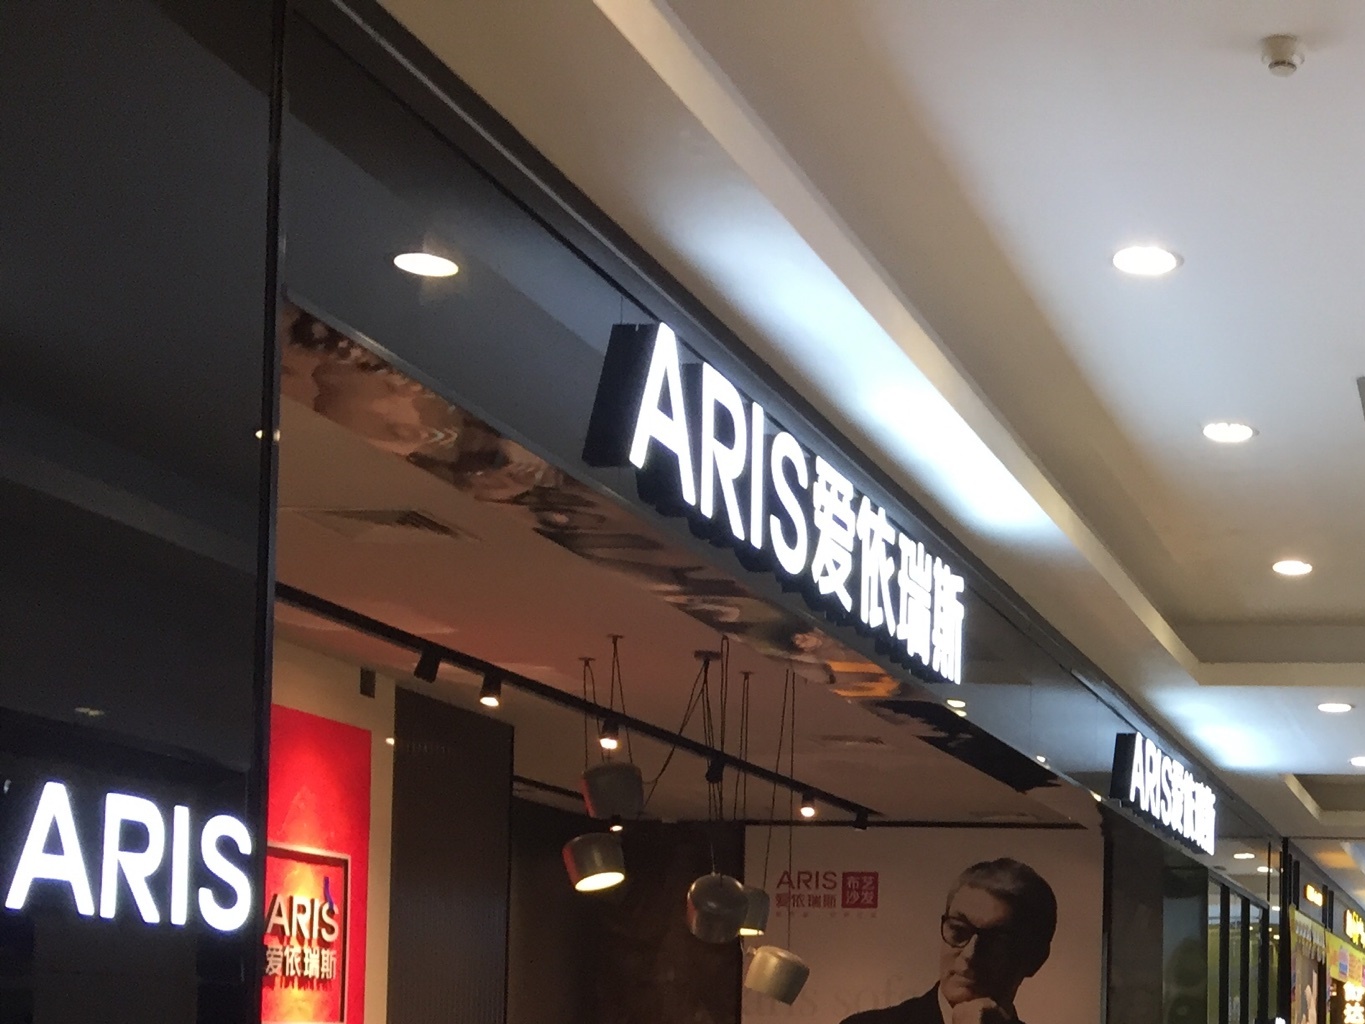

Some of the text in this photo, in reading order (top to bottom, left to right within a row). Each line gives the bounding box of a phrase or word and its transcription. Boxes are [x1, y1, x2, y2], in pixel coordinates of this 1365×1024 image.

[5, 781, 252, 931] ARIS
[776, 870, 837, 890] ARIS
[265, 892, 339, 943] ARIS
[265, 944, 337, 981] 爱依瑞斯
